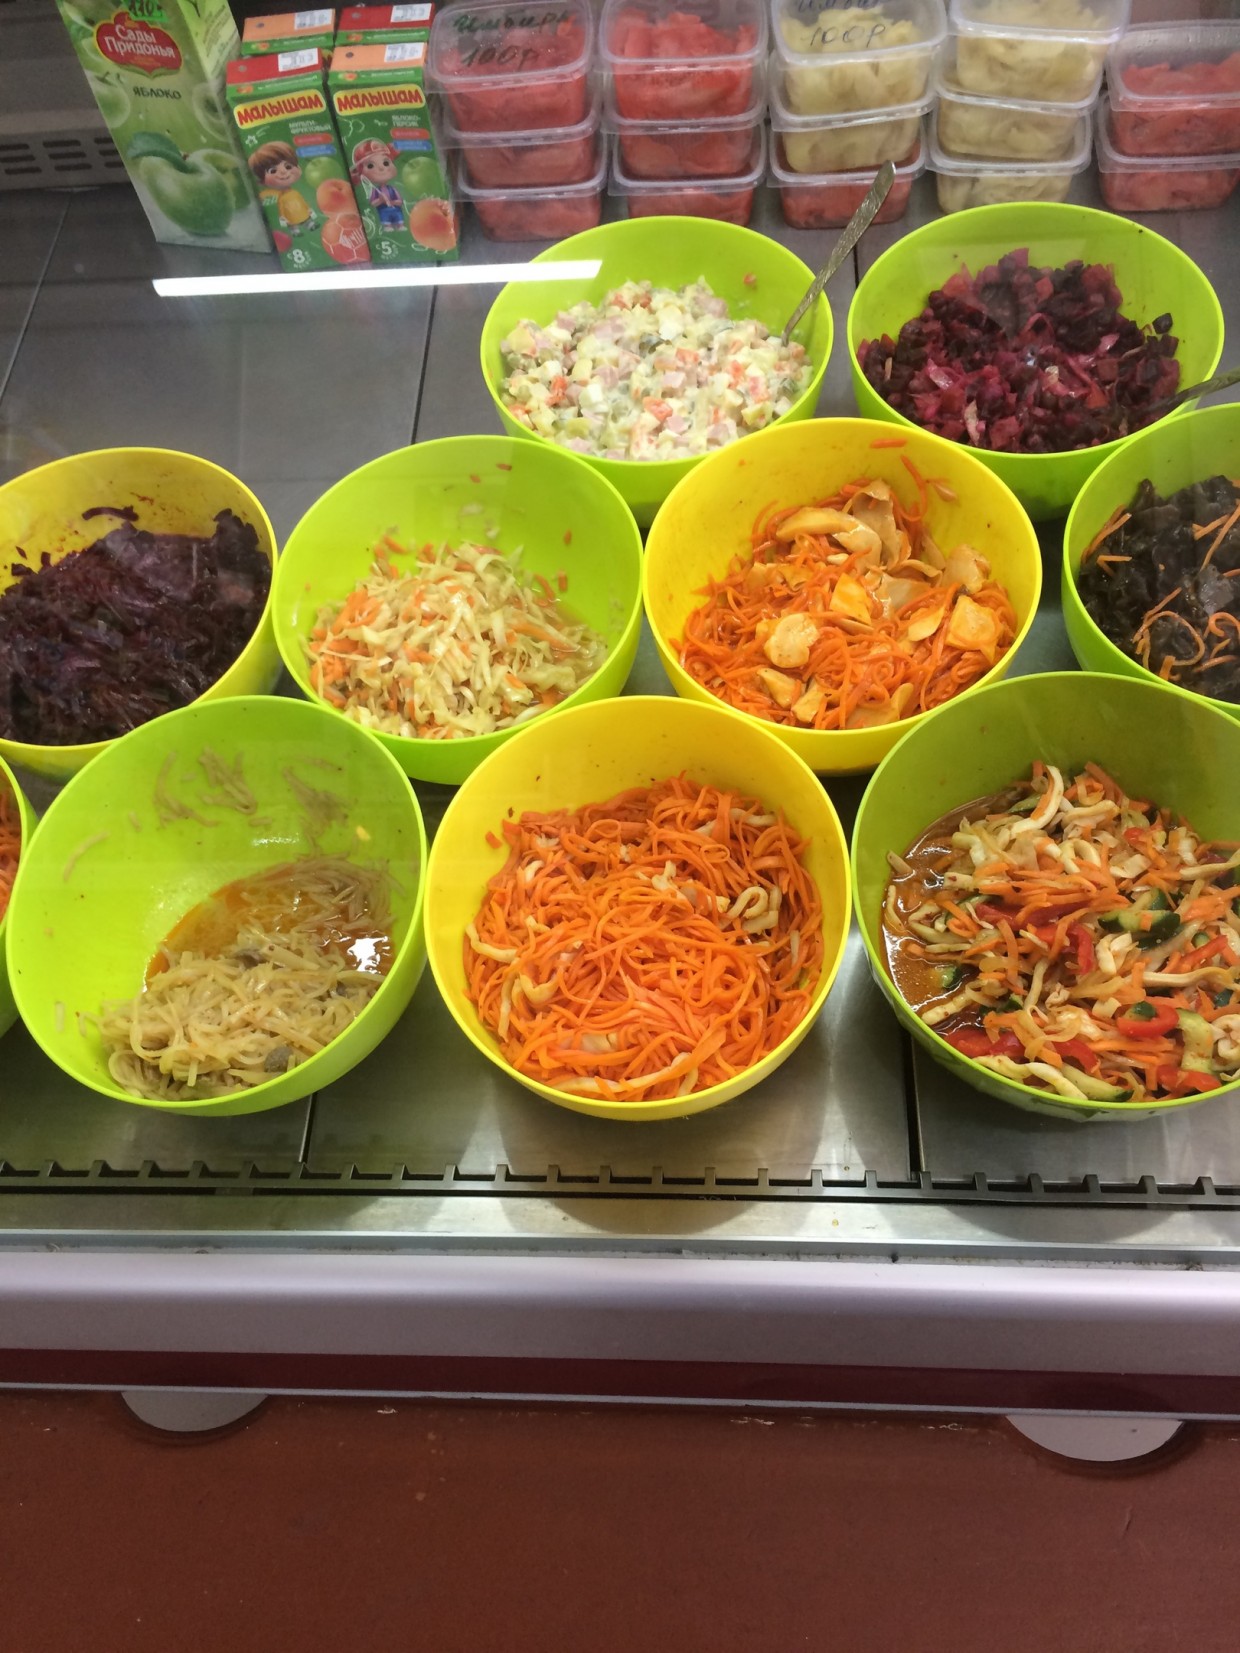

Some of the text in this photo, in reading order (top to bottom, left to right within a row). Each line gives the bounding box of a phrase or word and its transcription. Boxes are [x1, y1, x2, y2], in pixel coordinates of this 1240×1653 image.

[115, 24, 157, 43] Сады
[104, 36, 176, 58] Придонья
[132, 86, 182, 99] ЯБЛОКО
[381, 241, 393, 255] 5
[292, 249, 305, 263] 8
